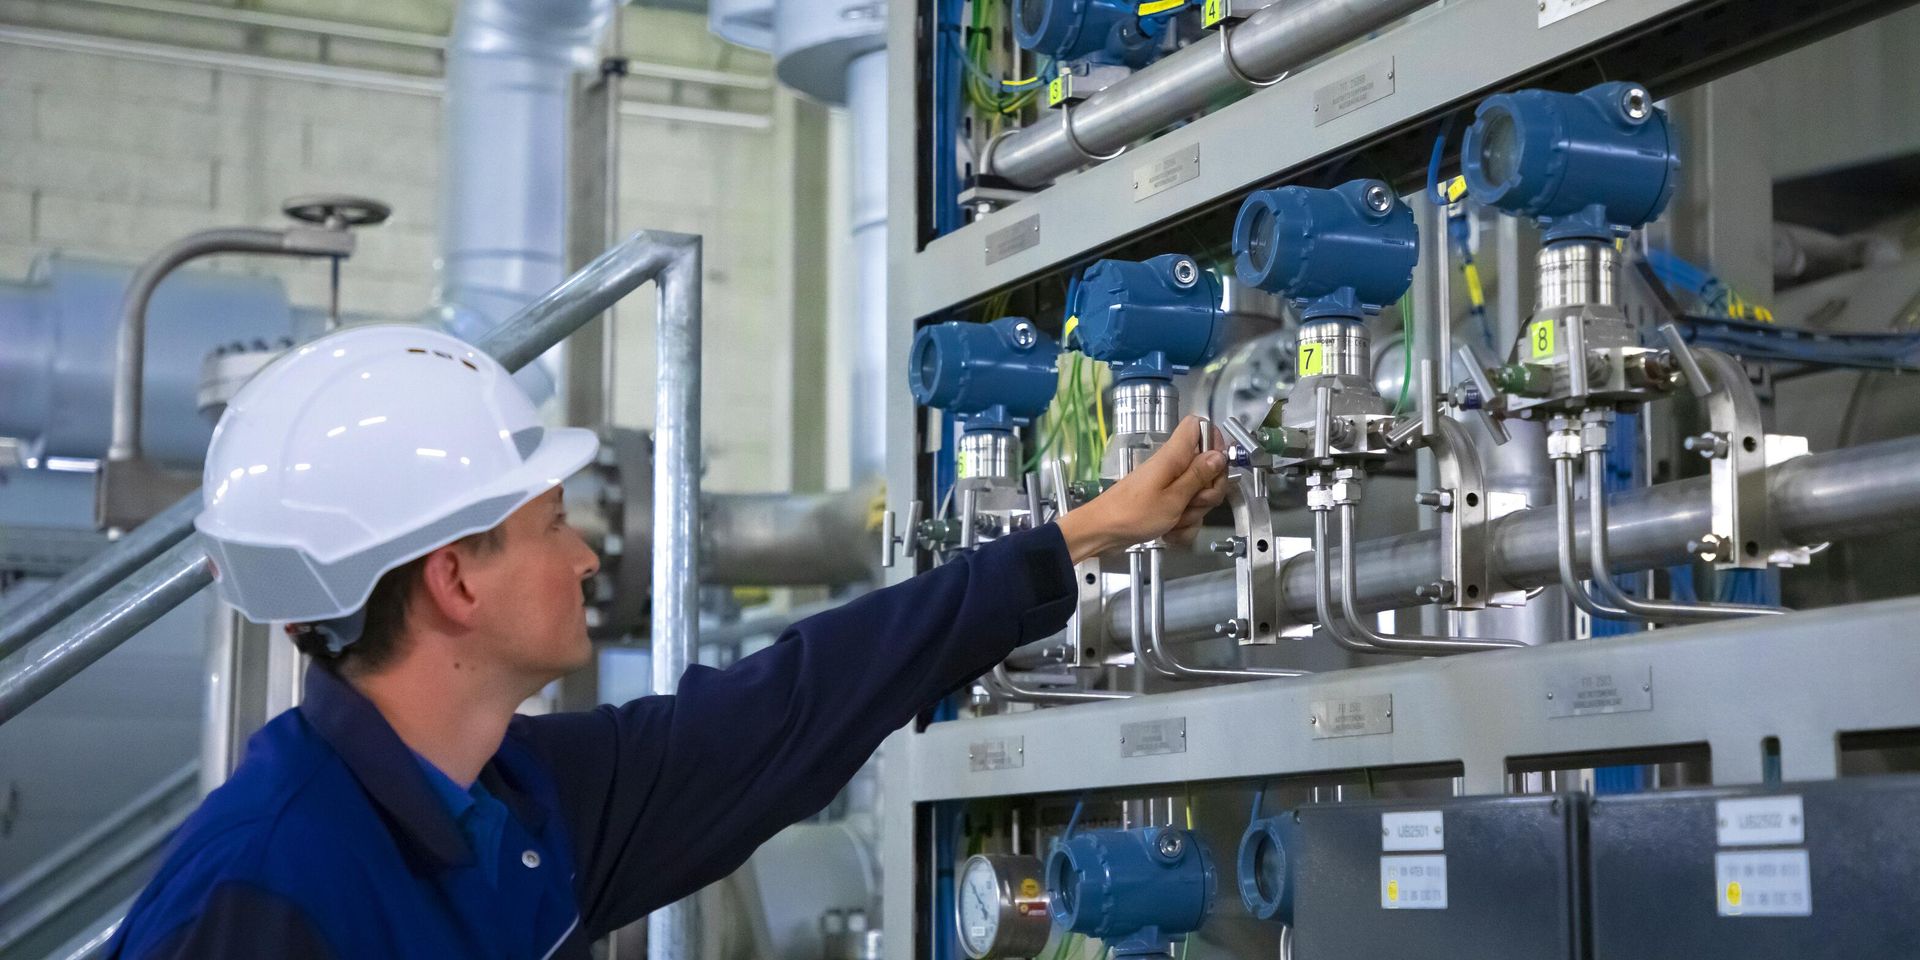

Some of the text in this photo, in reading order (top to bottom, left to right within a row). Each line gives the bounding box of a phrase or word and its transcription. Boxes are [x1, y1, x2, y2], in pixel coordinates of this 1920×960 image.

[1209, 1, 1215, 18] 4
[1052, 81, 1058, 99] 3
[1538, 327, 1547, 351] 8
[1303, 348, 1314, 370] 7
